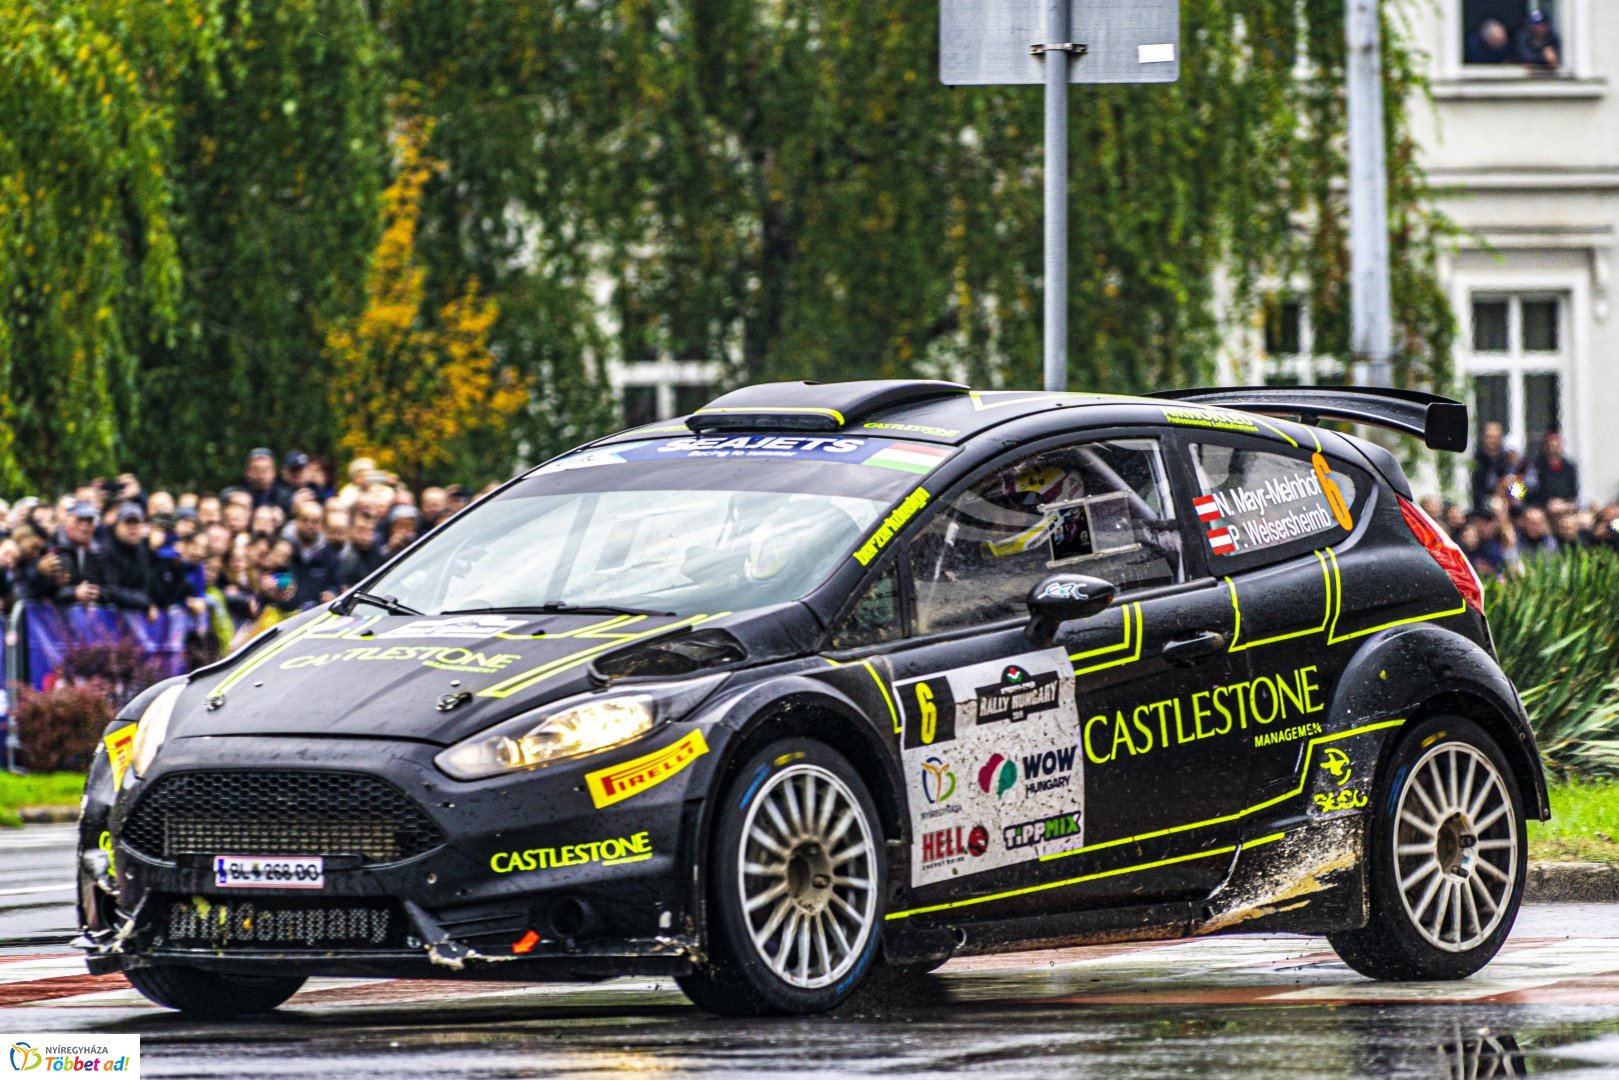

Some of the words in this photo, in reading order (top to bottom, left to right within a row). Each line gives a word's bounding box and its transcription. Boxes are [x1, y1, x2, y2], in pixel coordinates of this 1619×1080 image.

[657, 436, 865, 453] SEAJETS
[1212, 491, 1235, 518] N.
[1311, 451, 1354, 532] 6
[1243, 502, 1333, 547] Welsersheimb
[915, 682, 937, 744] 6
[1084, 664, 1325, 765] CASTLESTONE
[600, 740, 695, 797] PIRELLI
[1022, 745, 1078, 780] WOW
[1025, 774, 1072, 796] HUNGARY
[490, 831, 653, 873] CASTLESTONE
